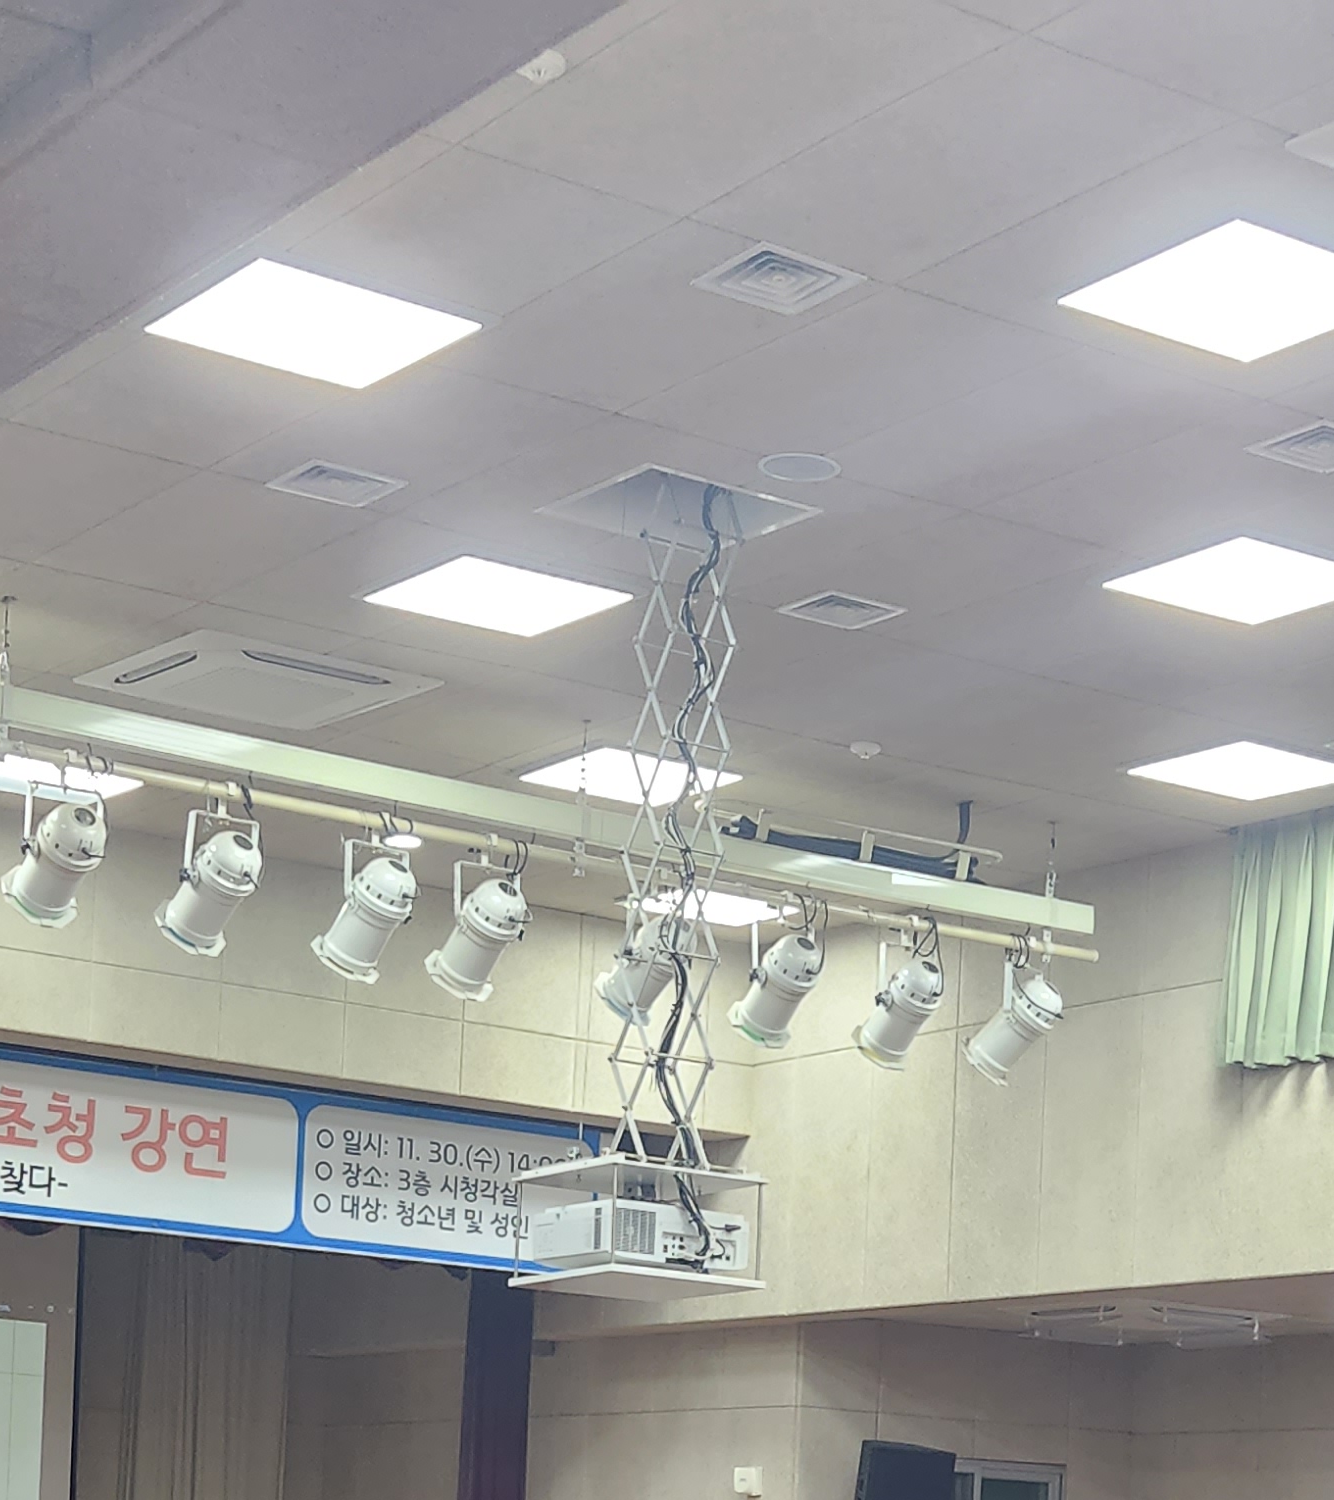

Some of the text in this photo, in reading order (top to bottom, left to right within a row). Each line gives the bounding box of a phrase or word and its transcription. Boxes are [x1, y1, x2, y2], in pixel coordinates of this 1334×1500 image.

[119, 1105, 229, 1180] 강연
[342, 1129, 389, 1158] 일시:
[396, 1136, 421, 1162] 11.
[428, 1140, 501, 1175] 30.(수)
[342, 1162, 519, 1208] 장소: 3층 시청각실
[340, 1193, 529, 1240] 대상: 청소년 및 성인
